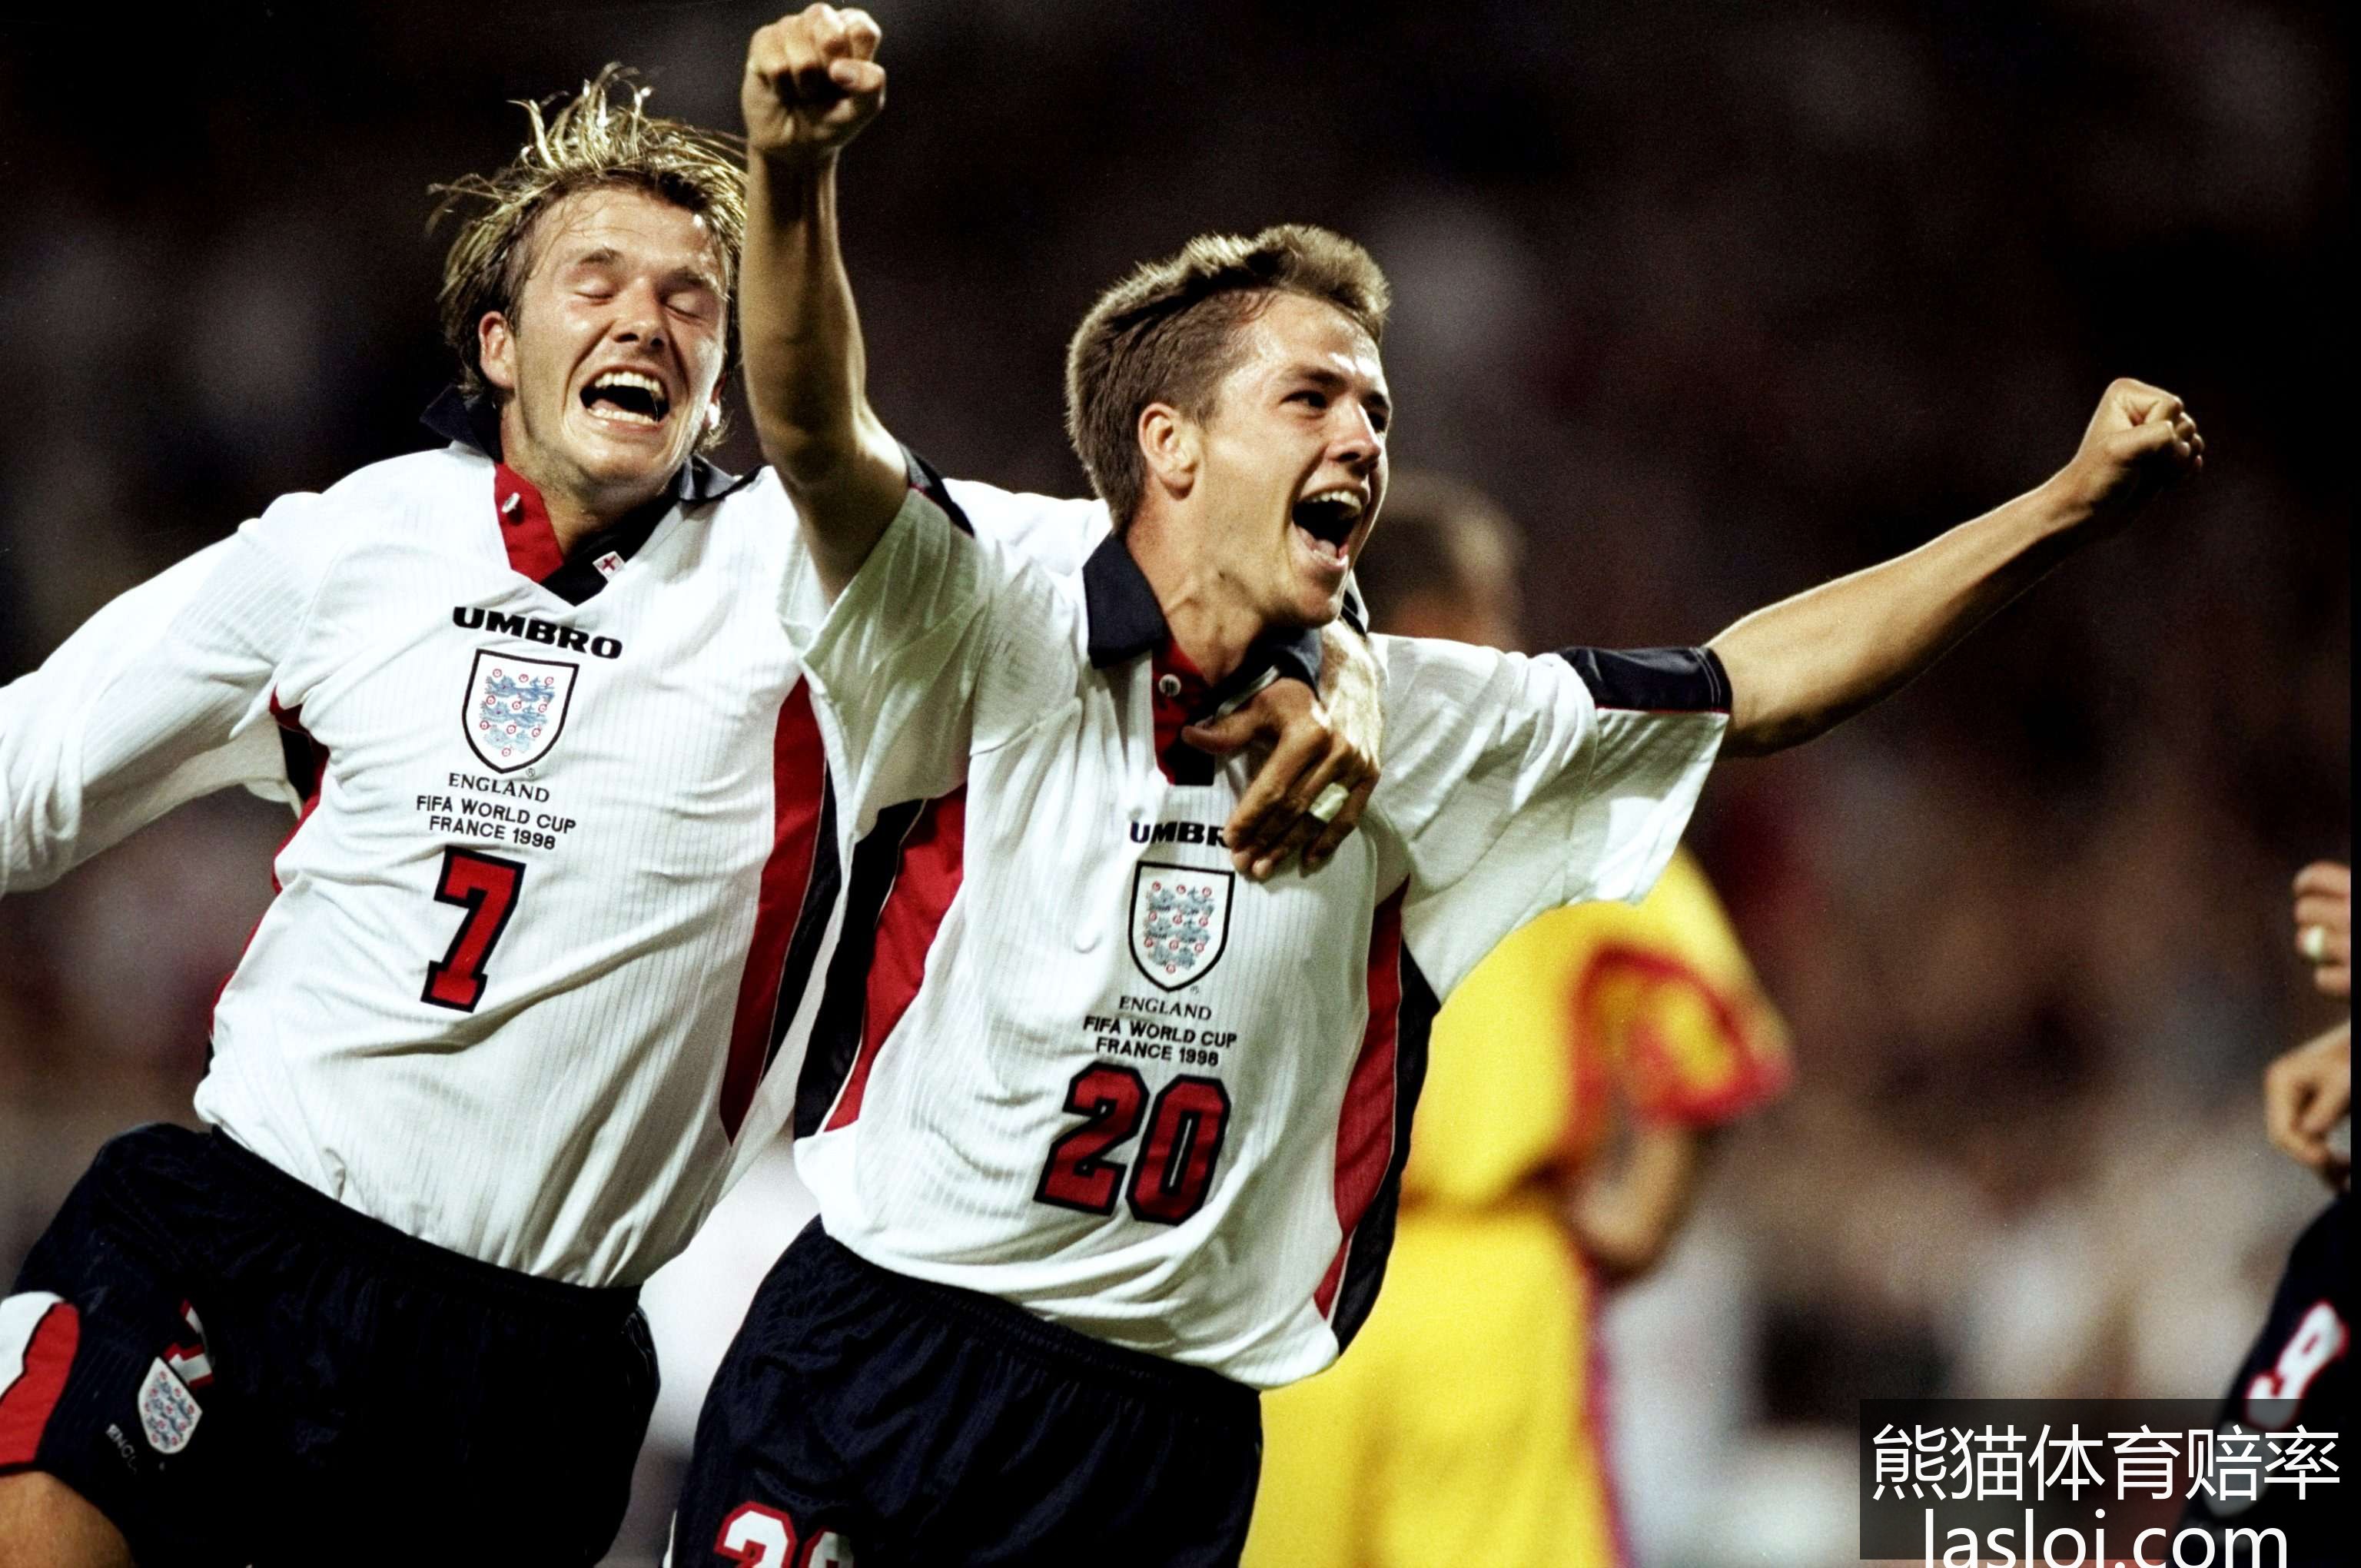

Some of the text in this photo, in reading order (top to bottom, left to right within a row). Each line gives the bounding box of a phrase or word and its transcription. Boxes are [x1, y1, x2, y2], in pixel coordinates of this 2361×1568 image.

[452, 606, 623, 659] UMBRO
[449, 772, 550, 803] ENGLAND
[416, 796, 577, 835] FIFA WORLD CUP
[429, 815, 556, 850] FRANCE 1998
[1130, 821, 1231, 849] UMBR
[420, 845, 526, 1013] 7
[1118, 995, 1212, 1021] ENGLAND
[1082, 1015, 1237, 1049] FIFA WORLD CUP
[1095, 1036, 1220, 1067] FRANCE 1998
[1033, 1061, 1232, 1227] 20
